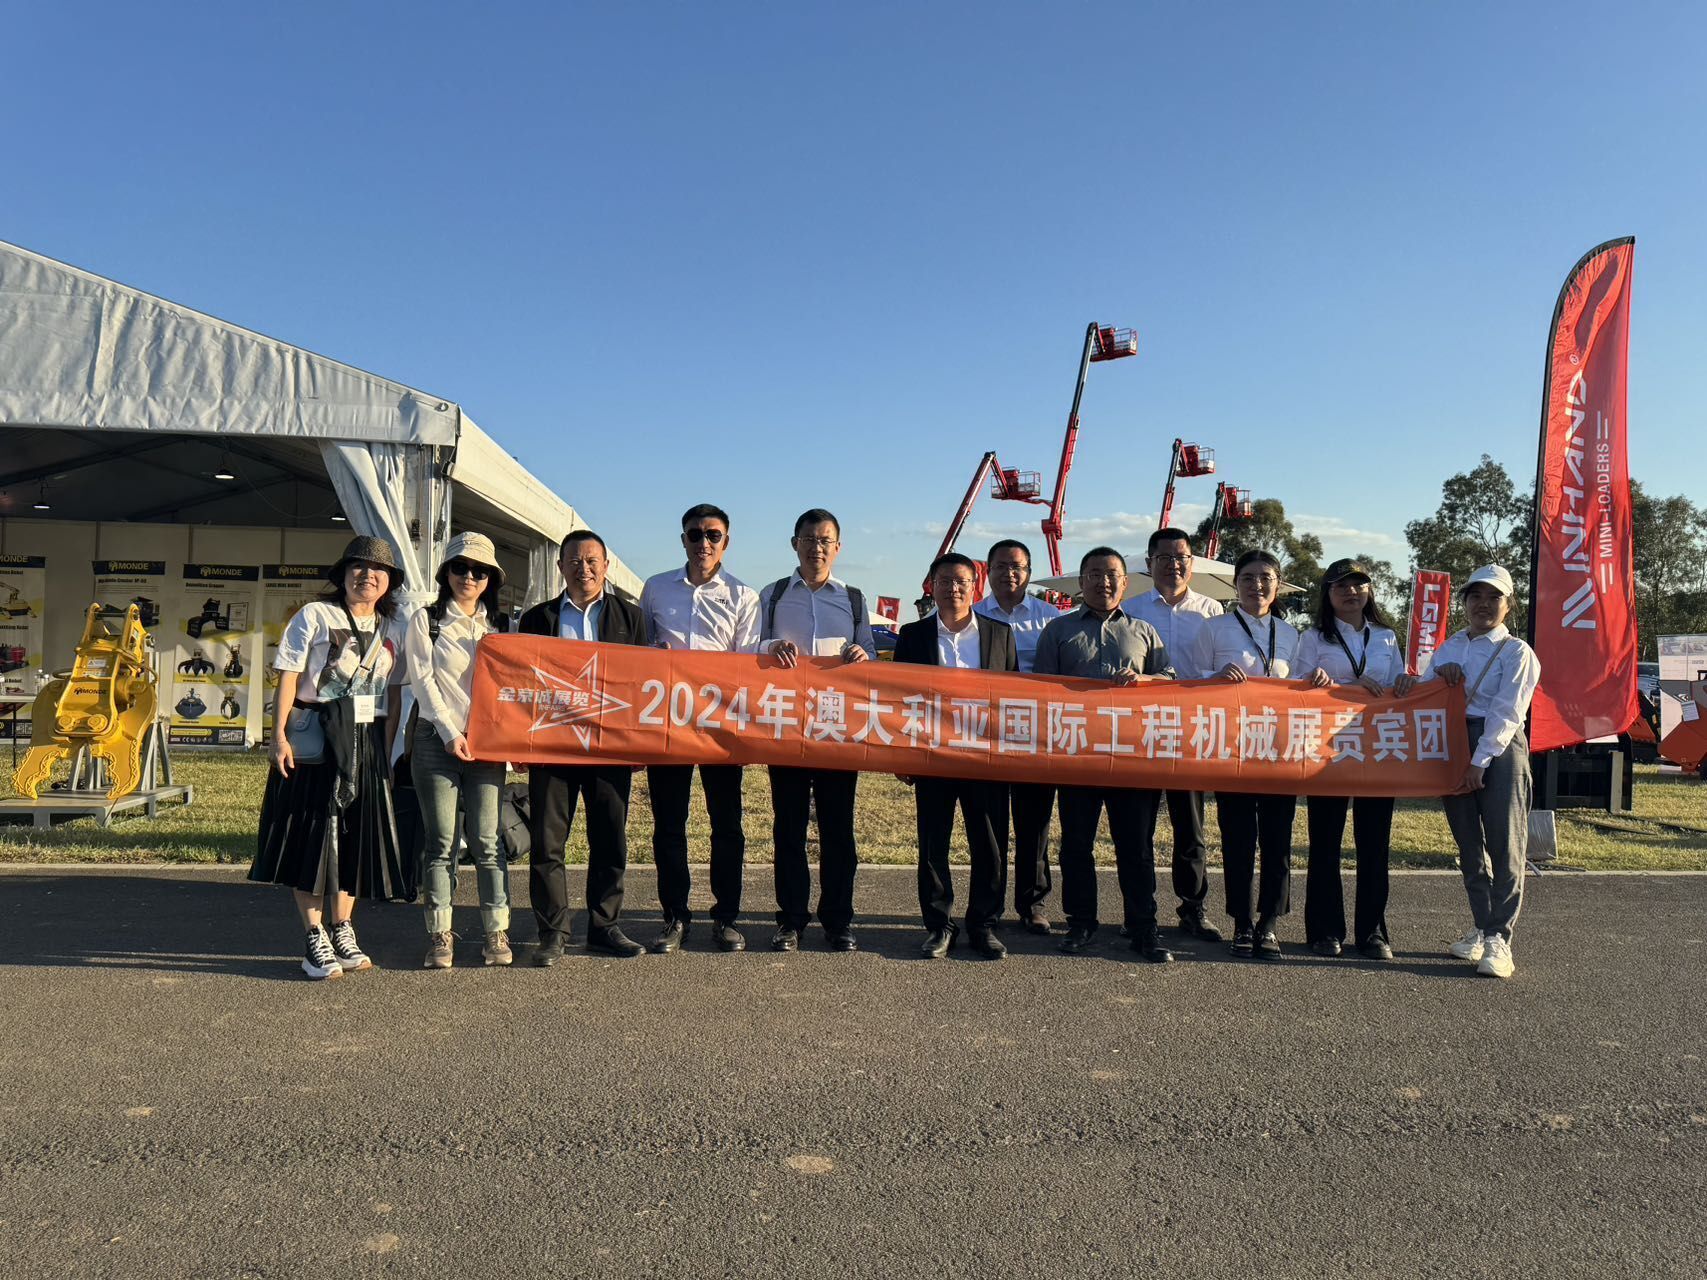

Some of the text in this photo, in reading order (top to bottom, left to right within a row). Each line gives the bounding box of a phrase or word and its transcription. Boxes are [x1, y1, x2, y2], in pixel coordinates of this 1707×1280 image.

[1597, 443, 1613, 558] MINI-LOADERS
[118, 562, 150, 570] MONDE
[211, 568, 243, 576] MONDE
[289, 567, 320, 575] MONDE
[638, 679, 1450, 763] 2024年澳大利亚国际工程机械展贵宾团
